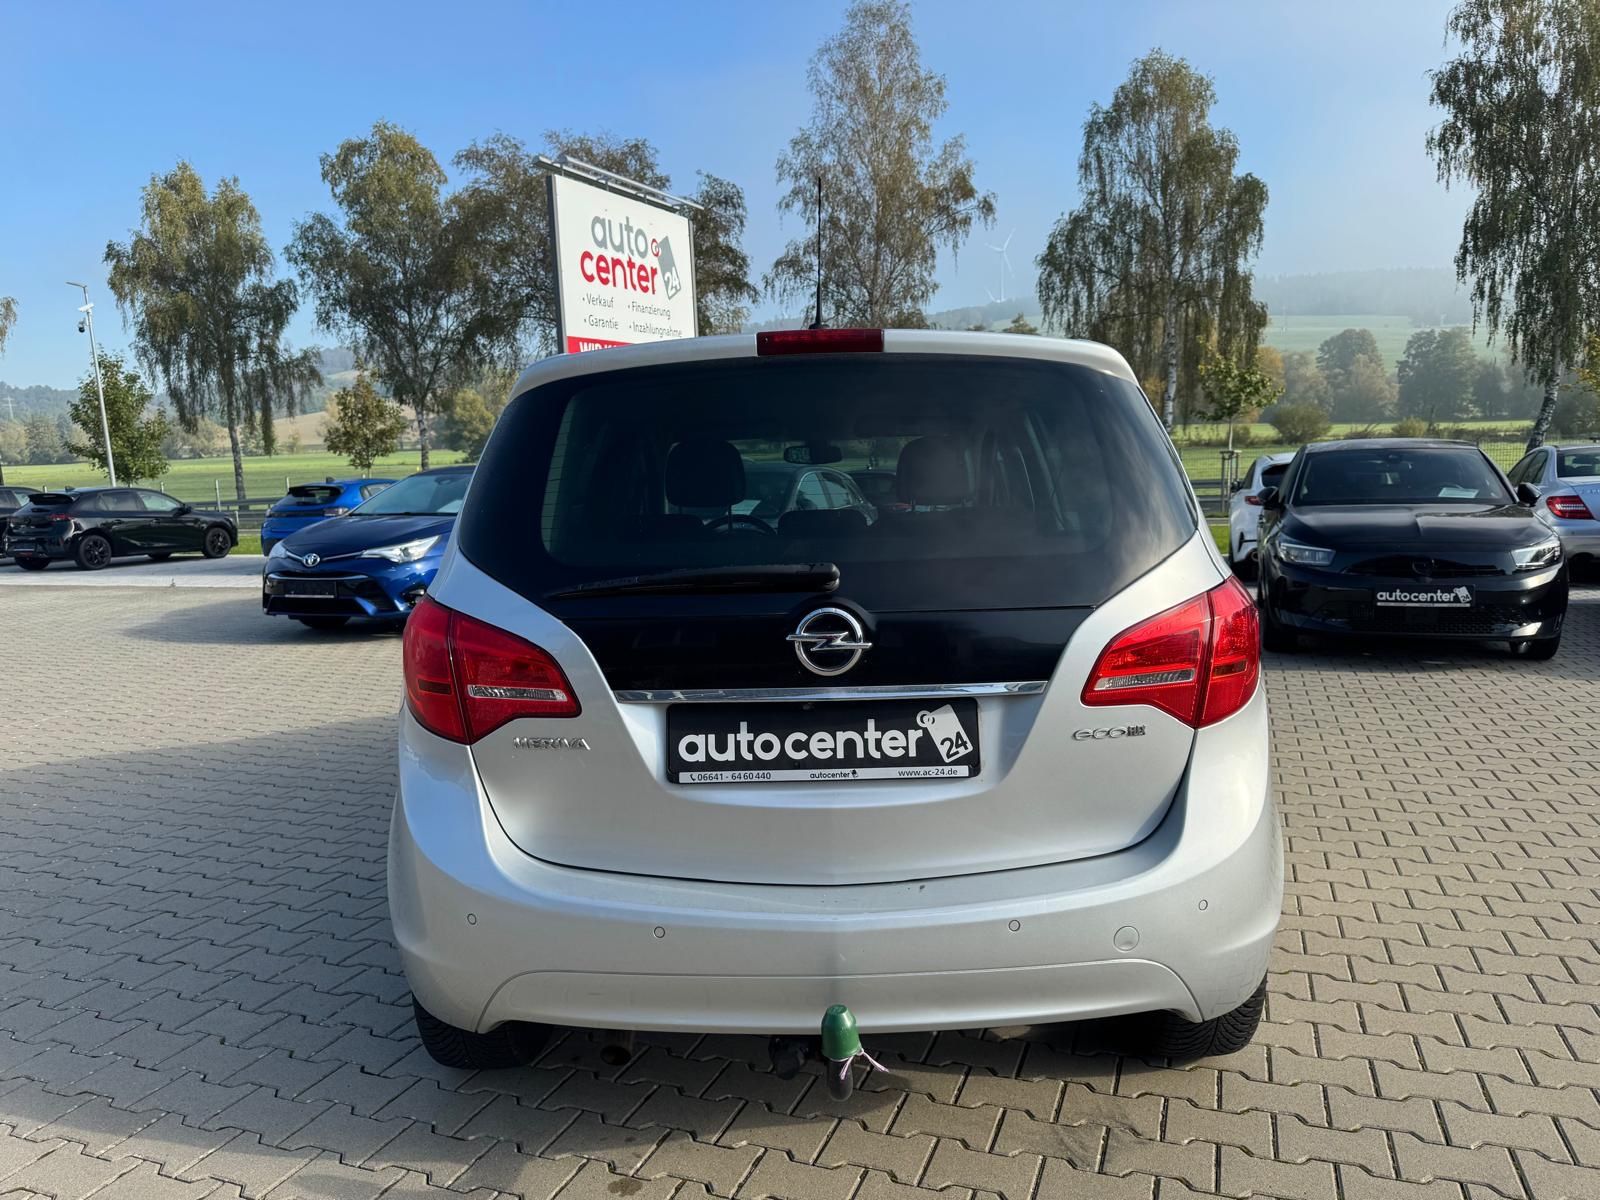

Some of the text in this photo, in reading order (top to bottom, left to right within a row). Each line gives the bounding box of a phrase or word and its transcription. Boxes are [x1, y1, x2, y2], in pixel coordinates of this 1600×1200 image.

[591, 215, 648, 259] auto
[580, 250, 658, 295] center
[664, 269, 680, 294] 24
[586, 293, 614, 308] Verkauf
[631, 301, 671, 320] Finanzierung
[588, 314, 619, 330] Garantie
[633, 321, 682, 338] Inzahlungnahme
[1376, 588, 1456, 602] autocenter
[678, 718, 923, 762] autocenter
[939, 730, 970, 760] 24
[809, 770, 850, 779] autocenter
[898, 767, 958, 777] www.ac-24.de
